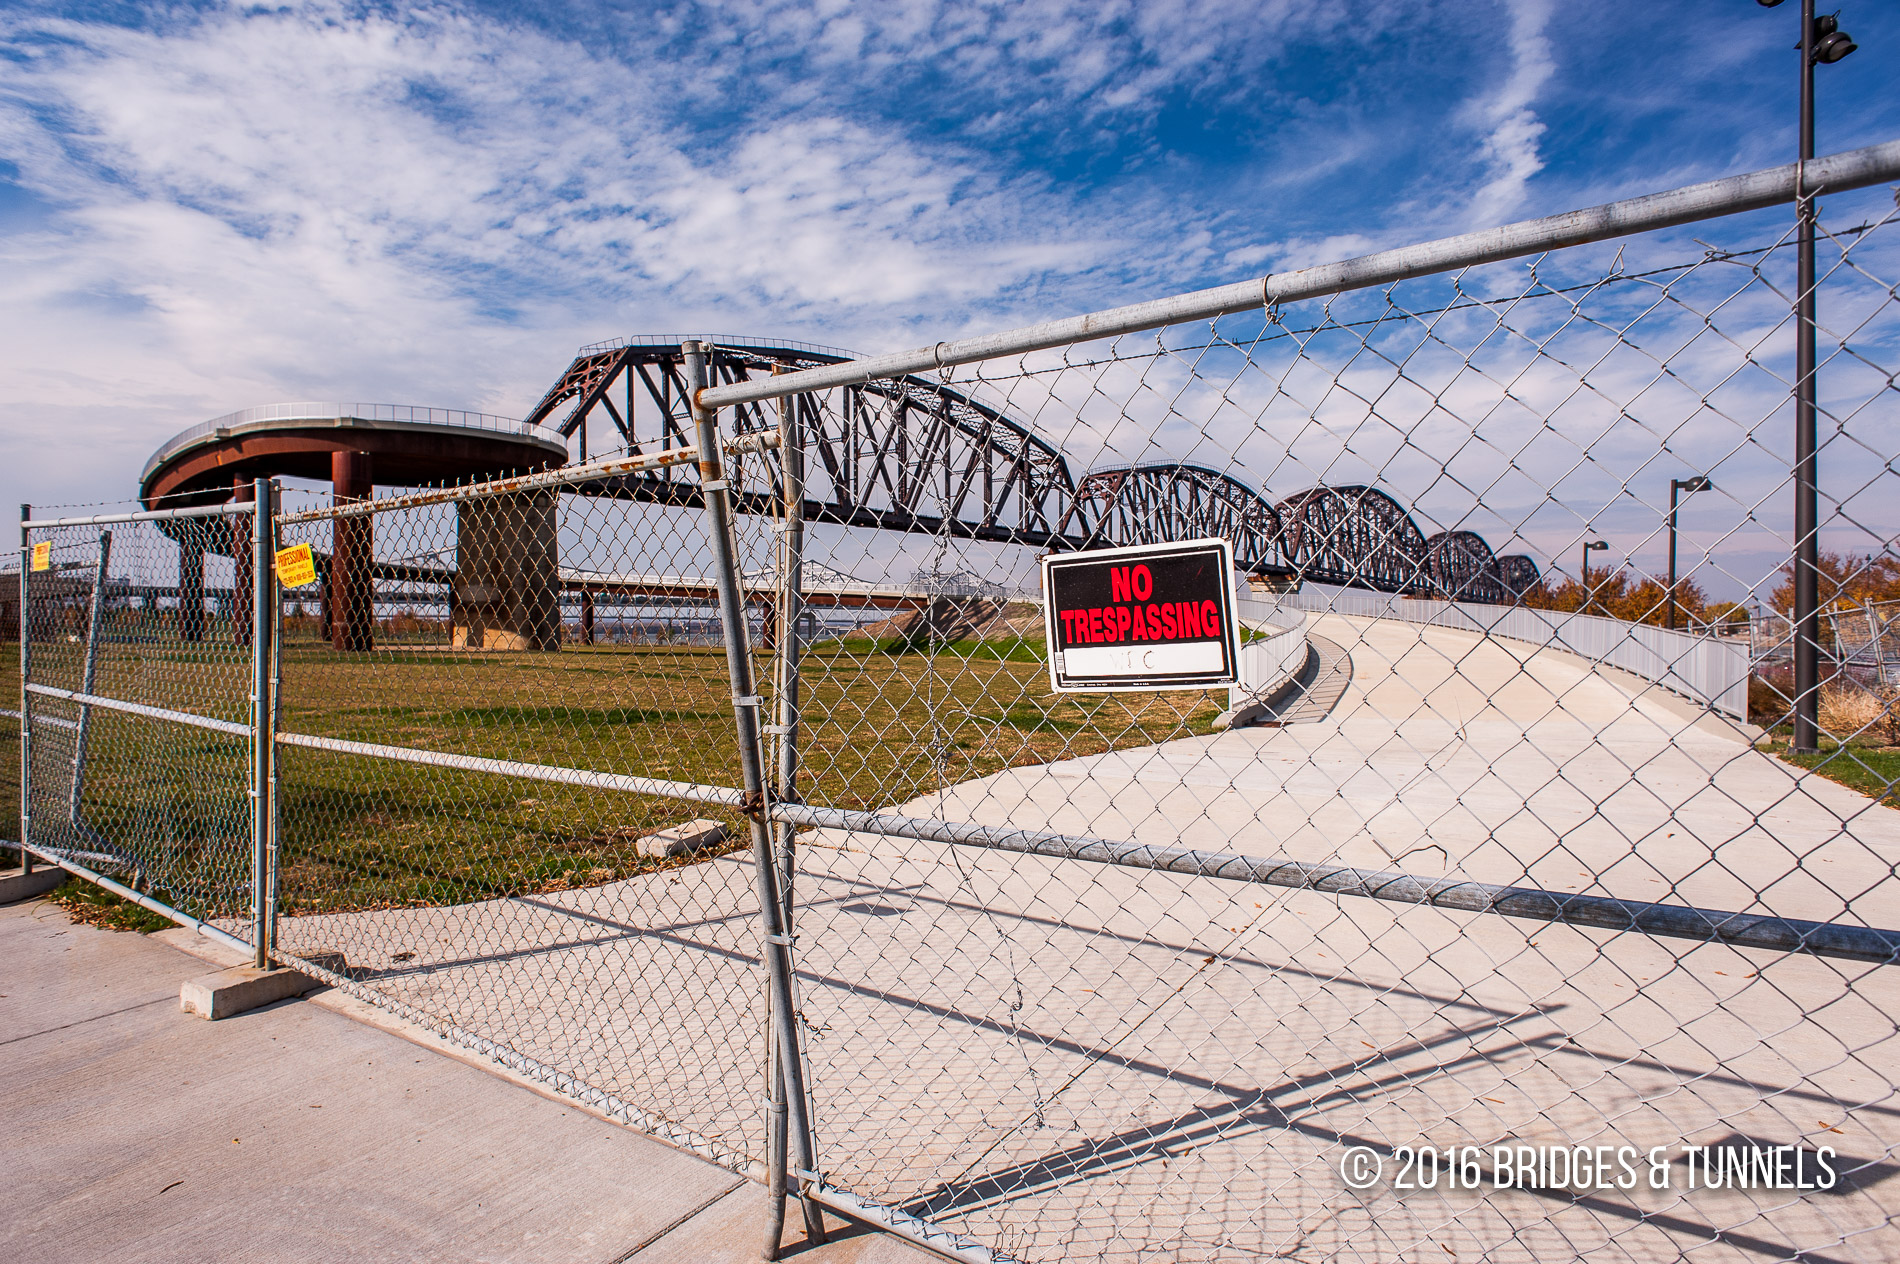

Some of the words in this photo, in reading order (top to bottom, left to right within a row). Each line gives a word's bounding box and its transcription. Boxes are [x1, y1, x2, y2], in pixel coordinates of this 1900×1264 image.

[278, 547, 310, 568] PROFESSIONAL
[1110, 564, 1153, 602] NO
[1060, 599, 1221, 644] TRESPASSING
